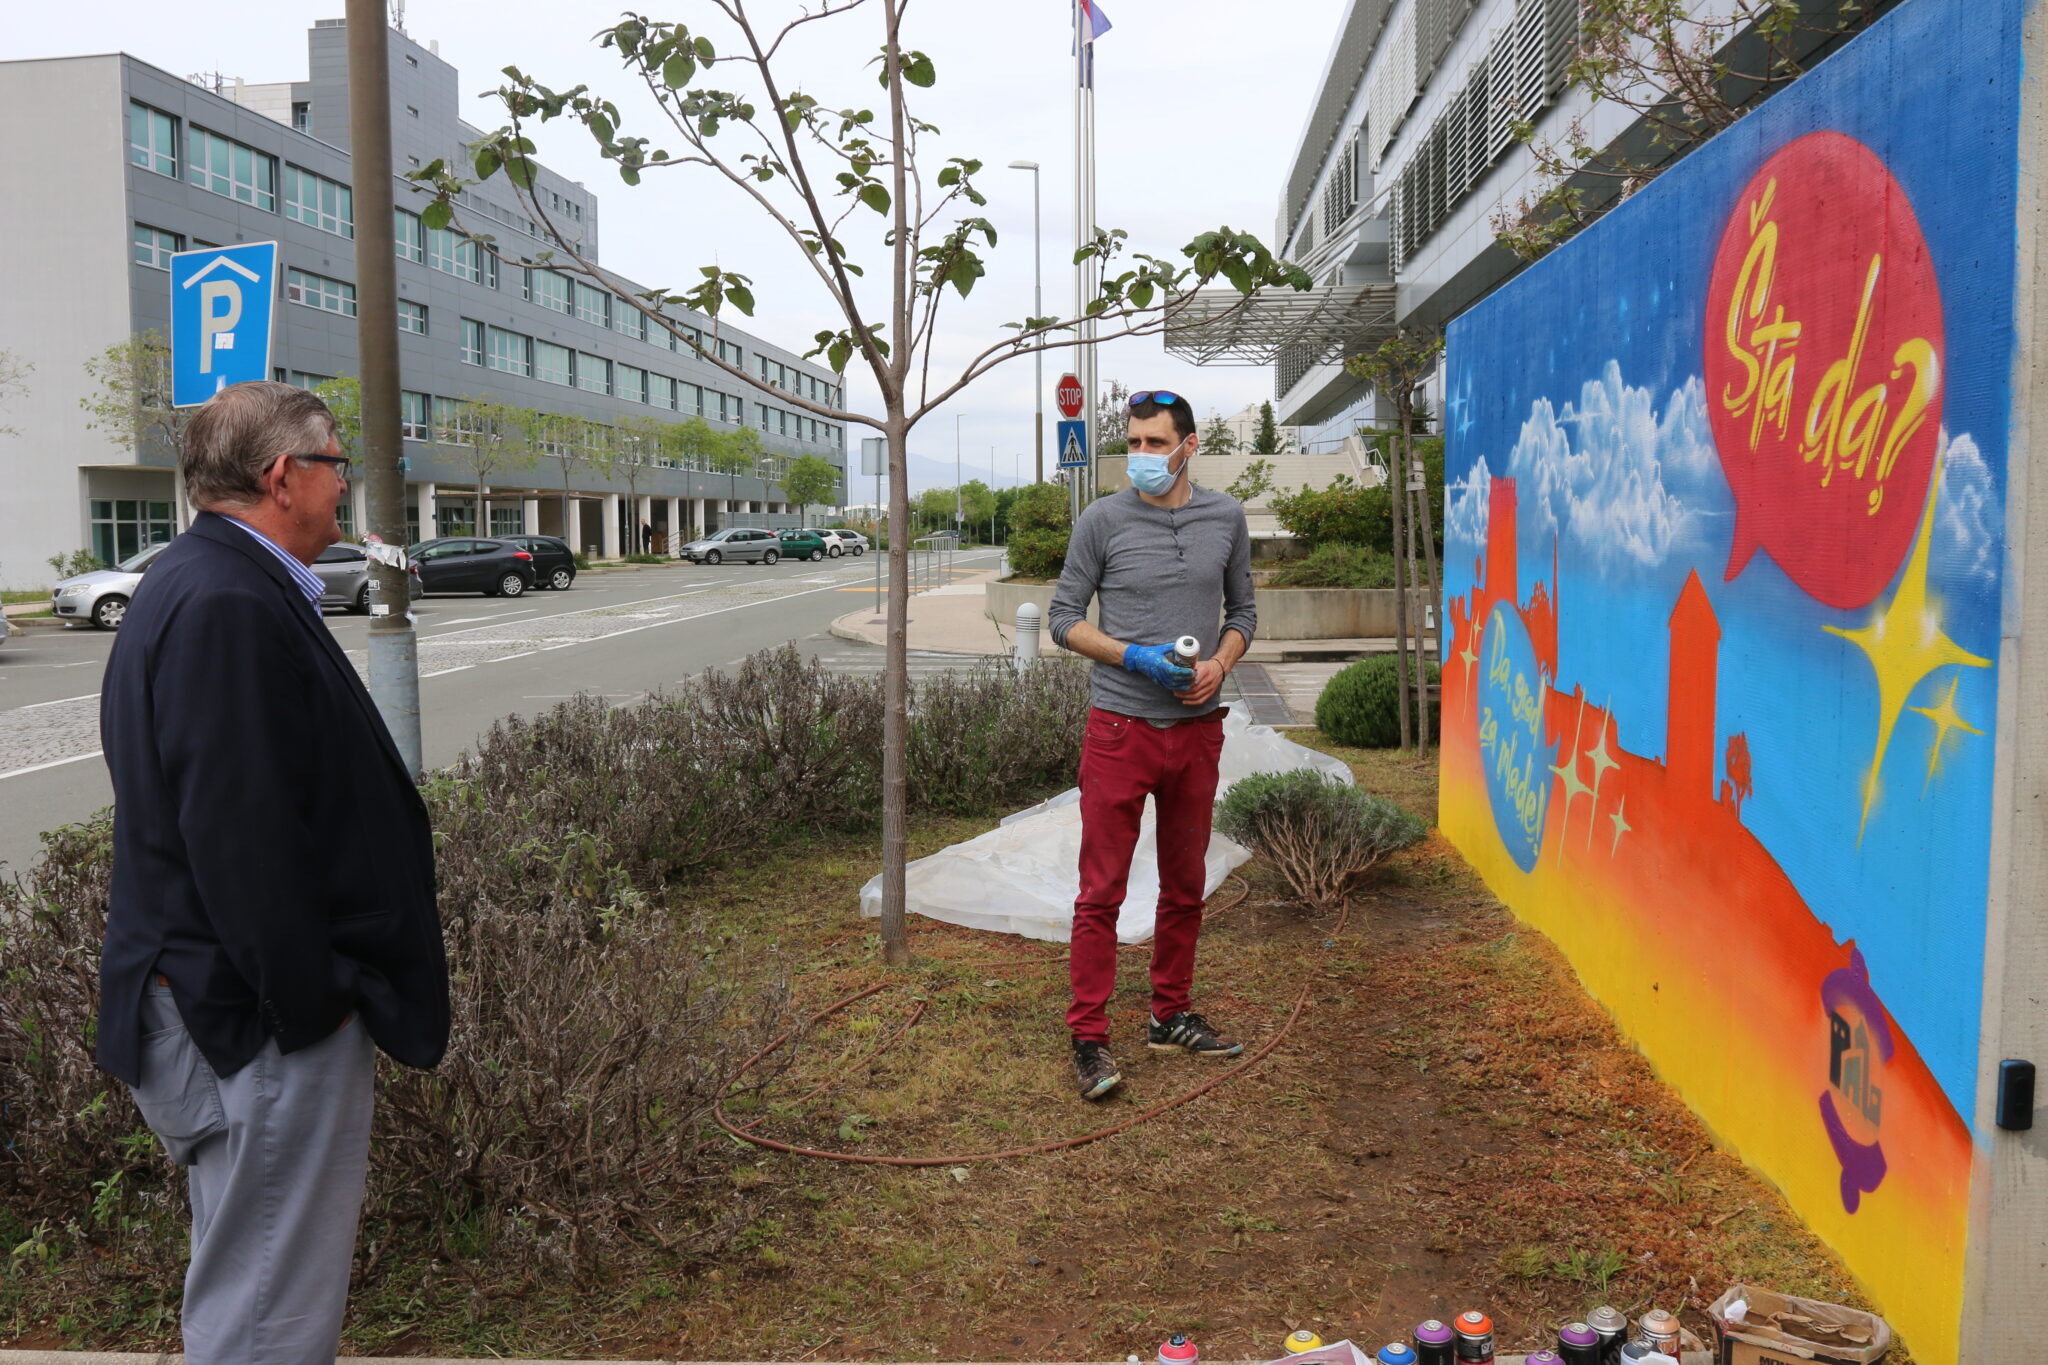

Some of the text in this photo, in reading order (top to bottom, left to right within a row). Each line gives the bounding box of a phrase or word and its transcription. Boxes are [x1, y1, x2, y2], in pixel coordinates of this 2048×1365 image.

[200, 279, 242, 374] P
[1722, 177, 1939, 515] Šta da?
[1059, 388, 1082, 406] STOP
